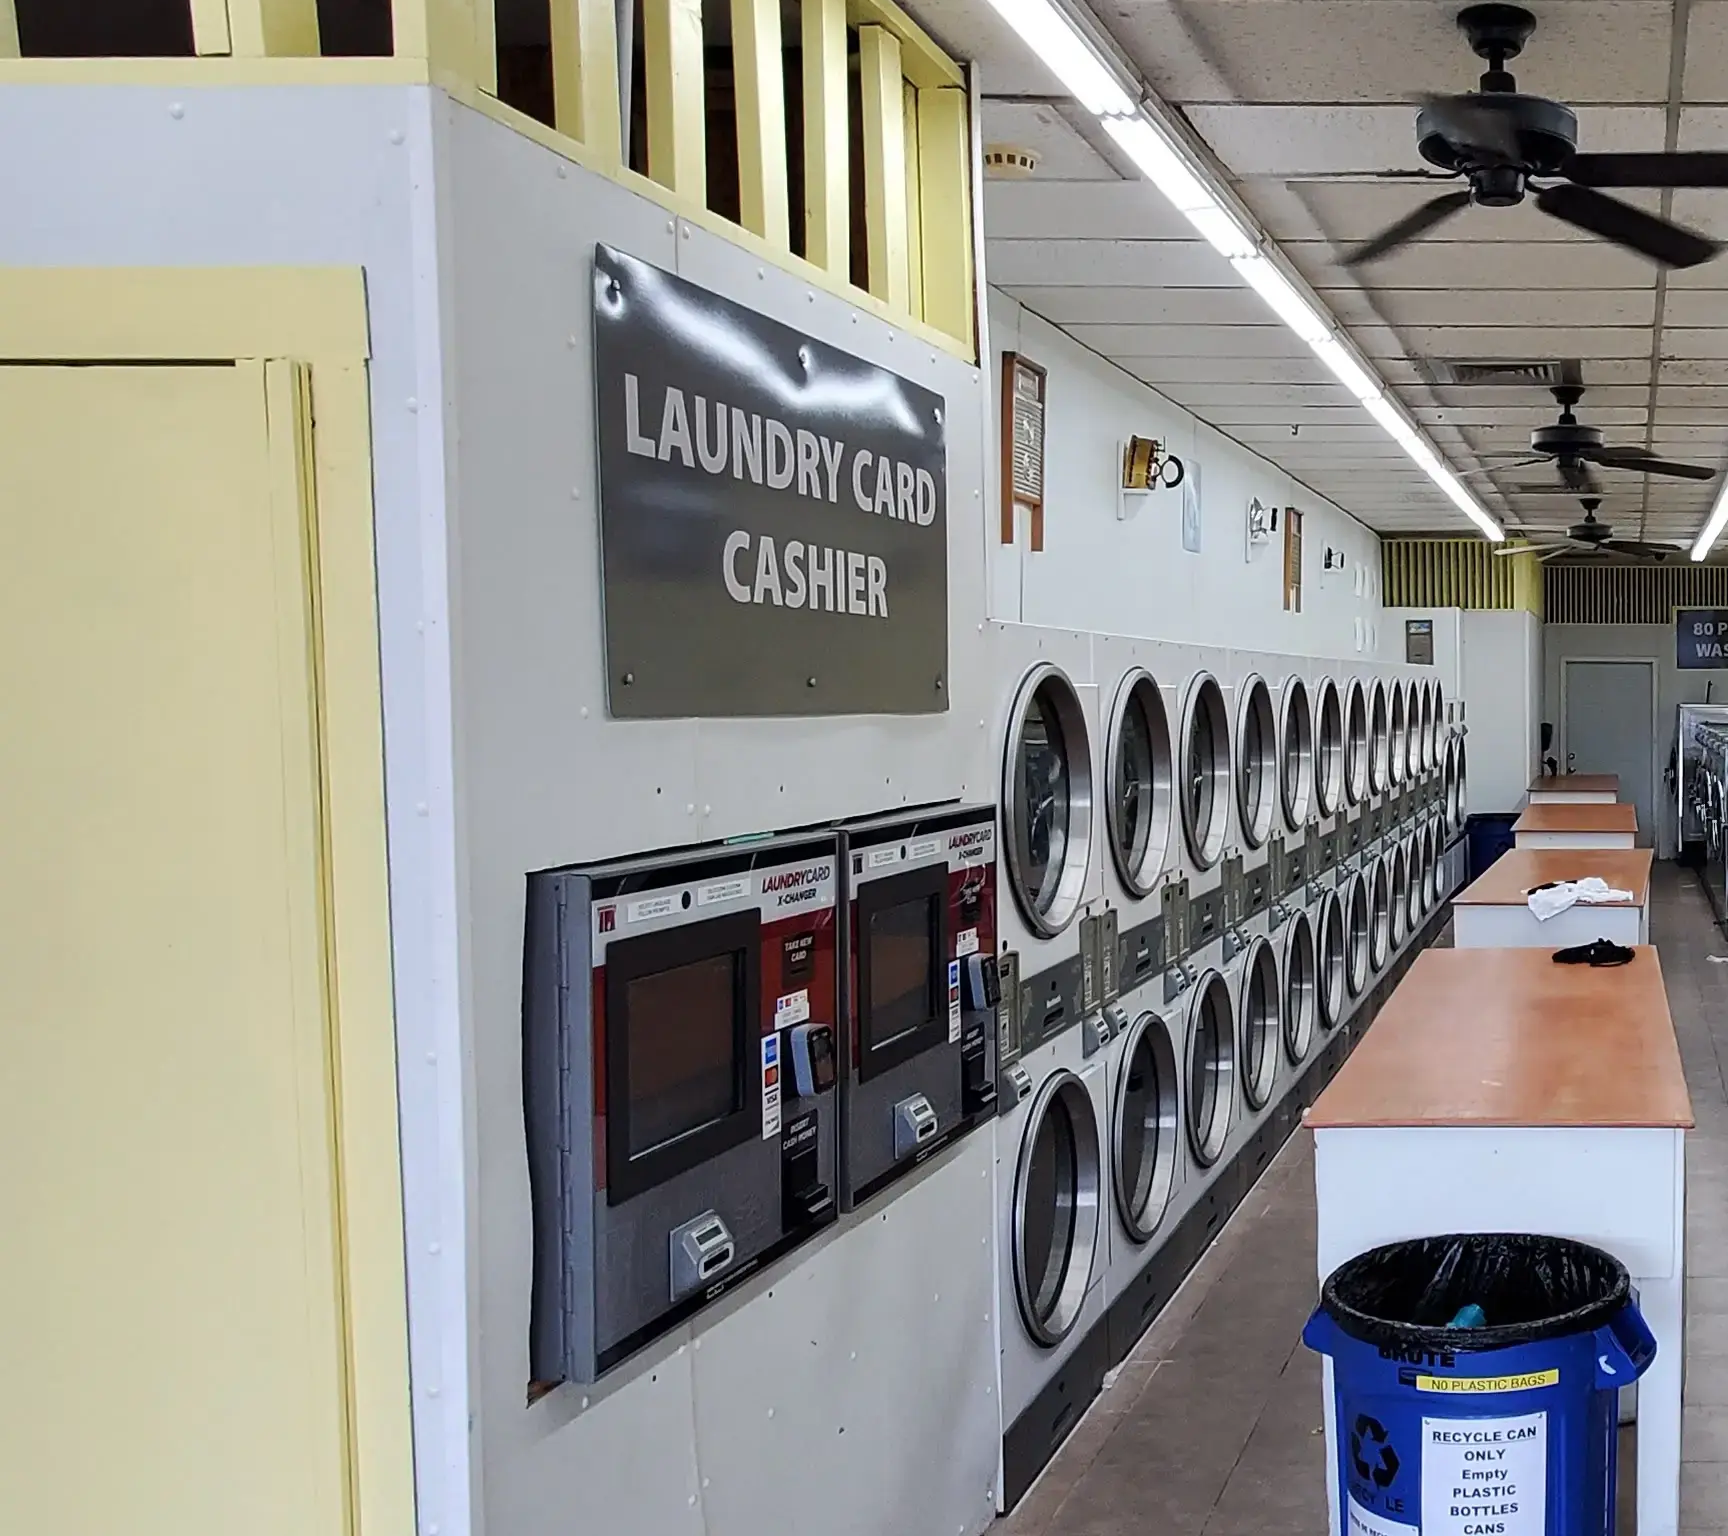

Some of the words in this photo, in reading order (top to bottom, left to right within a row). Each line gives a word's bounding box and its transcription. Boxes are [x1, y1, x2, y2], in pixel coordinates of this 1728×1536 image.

[624, 372, 845, 503] LAUNDRY
[852, 448, 937, 527] CARD
[723, 529, 889, 618] CASHIER
[1693, 622, 1714, 636] 80
[761, 865, 831, 894] LAUNDRYCARD
[777, 887, 817, 907] X-CHANGER
[1451, 1379, 1507, 1391] PLASTIC
[1510, 1375, 1546, 1388] BAGS
[1432, 1430, 1501, 1443] RECYCLE
[1507, 1426, 1537, 1440] CAN
[1464, 1449, 1506, 1462] ONLY
[1461, 1469, 1508, 1482] Empty
[1452, 1484, 1516, 1498] PLASTIC
[1450, 1502, 1519, 1517] BOTTLES
[1463, 1522, 1505, 1535] CANS
